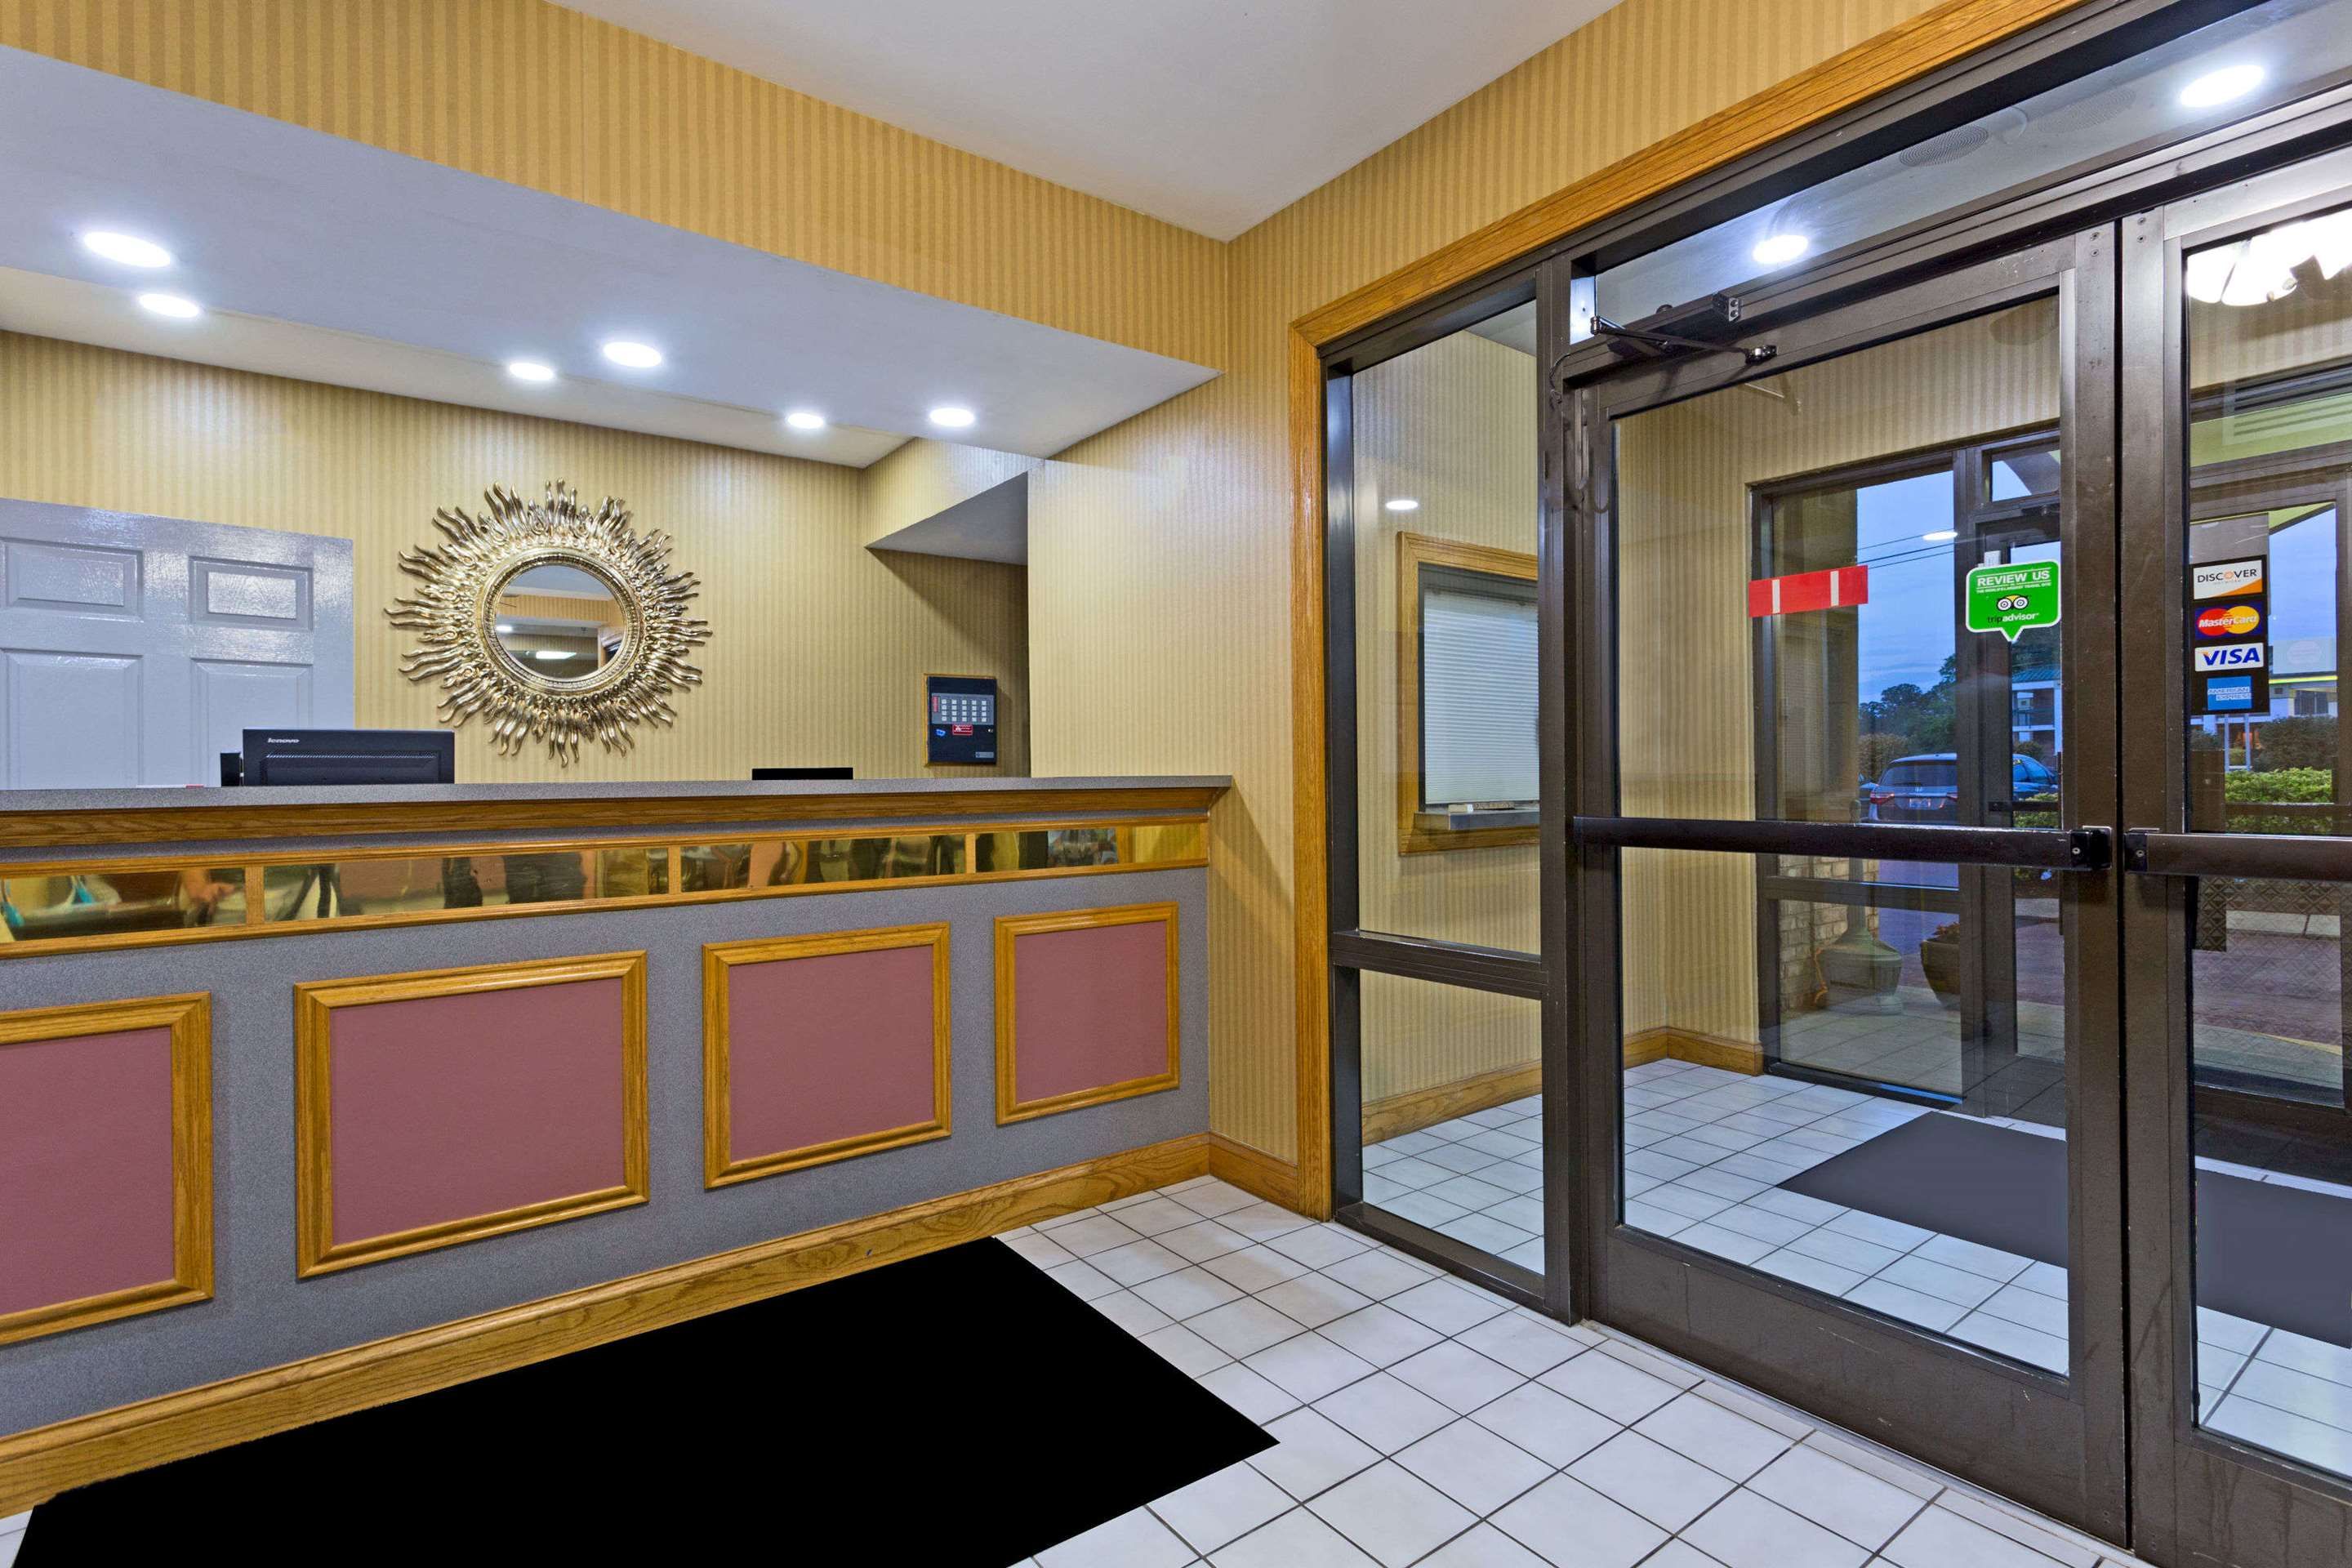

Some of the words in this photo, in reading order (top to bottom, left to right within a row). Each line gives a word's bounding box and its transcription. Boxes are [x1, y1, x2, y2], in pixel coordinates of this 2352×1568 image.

[1977, 573, 2027, 586] REVIEW
[2033, 570, 2050, 581] US
[2197, 568, 2257, 583] DISCOVER
[1988, 612, 2037, 624] tripadvisor
[2198, 615, 2256, 628] MasterCard
[2201, 648, 2261, 666] VISA
